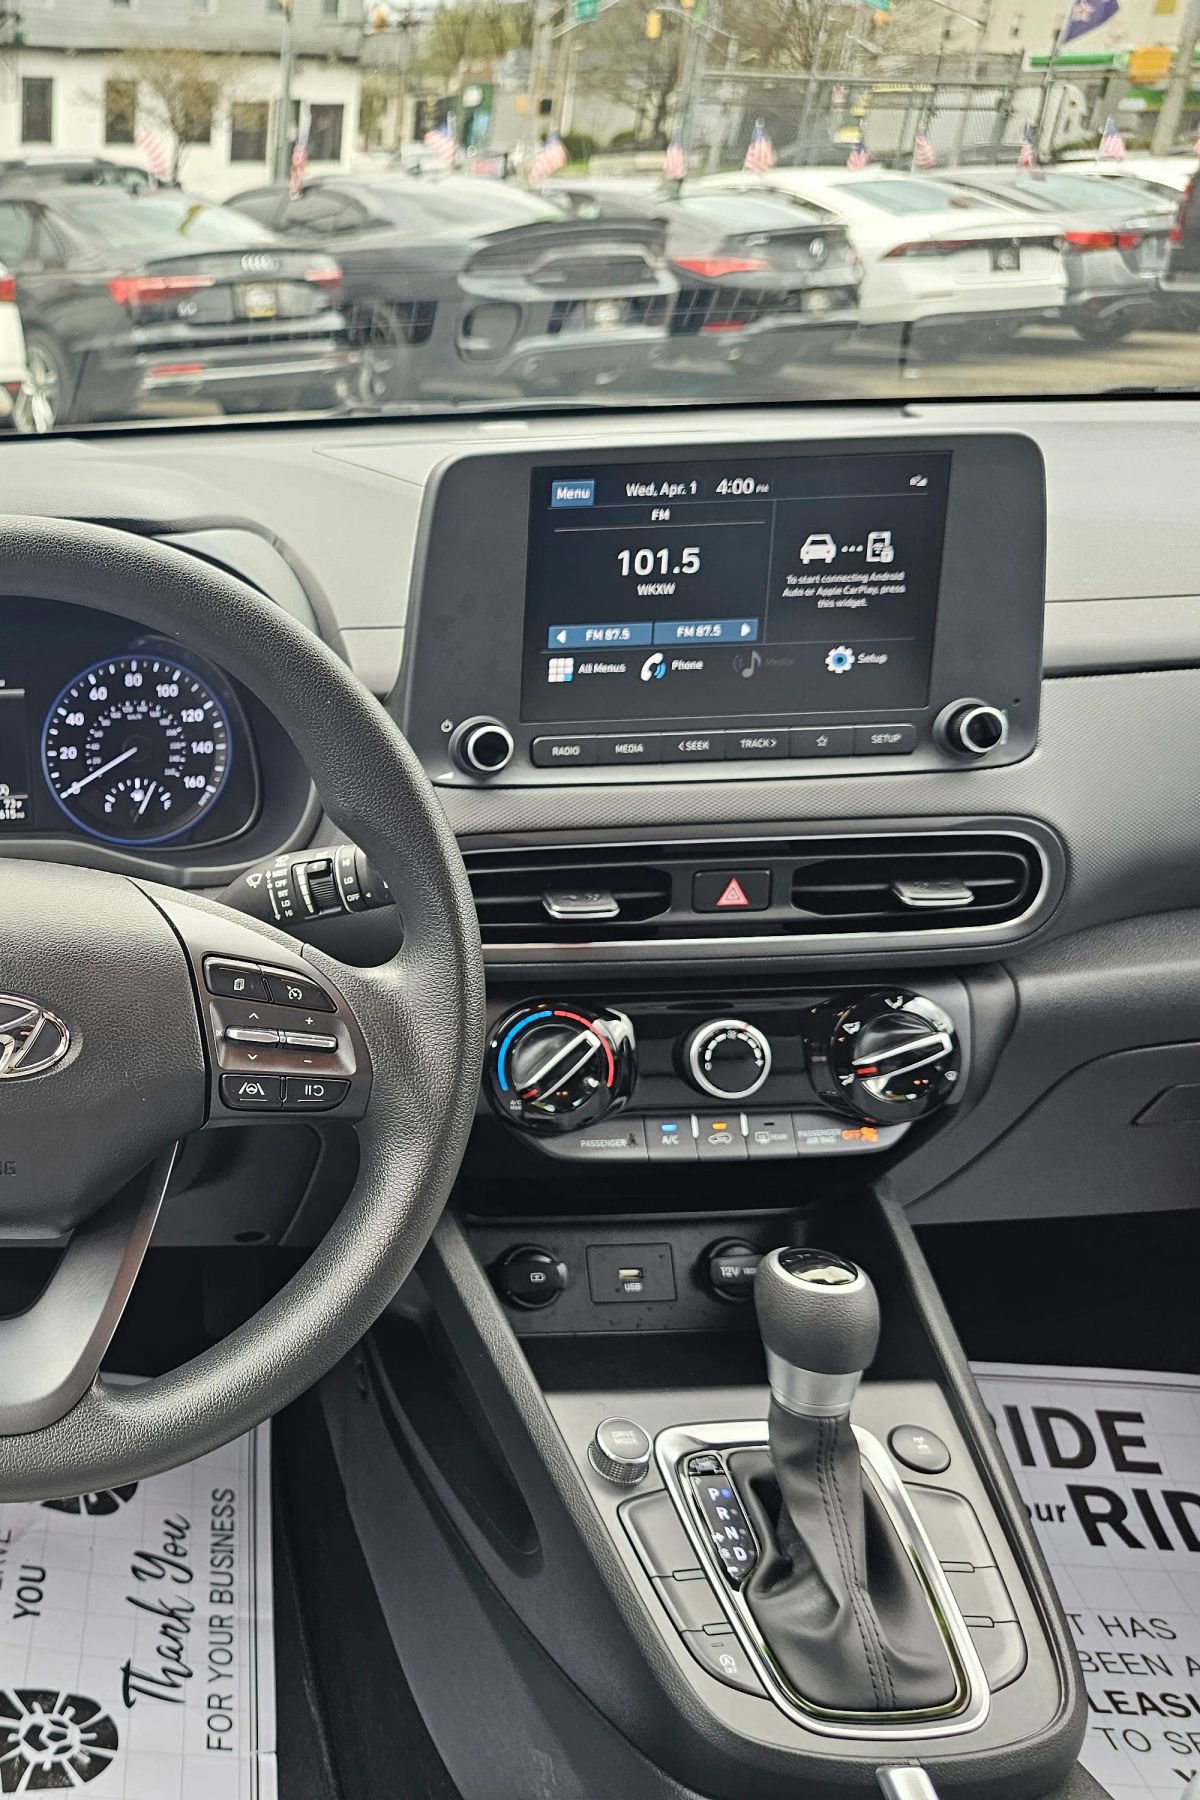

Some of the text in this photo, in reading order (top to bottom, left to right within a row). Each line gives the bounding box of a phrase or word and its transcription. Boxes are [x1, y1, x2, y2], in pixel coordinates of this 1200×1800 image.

[555, 487, 590, 500] Menu
[626, 481, 658, 497] Wed,
[659, 481, 687, 498] Apr.
[689, 480, 697, 495] 1
[715, 477, 755, 496] 4:00
[651, 507, 671, 522] FM
[617, 547, 700, 577] 101.5
[786, 570, 905, 585] To start connecting Android
[636, 582, 677, 597] WKXW
[782, 586, 804, 597] Auto
[804, 587, 816, 597] or
[816, 585, 842, 598] Apple
[880, 584, 906, 595] press
[817, 598, 835, 609] this
[585, 627, 631, 642] FM 87.5
[676, 624, 722, 638] FM 87.5
[671, 659, 704, 671] Phone
[857, 652, 888, 664] Setup
[578, 662, 627, 675] All Menus
[124, 673, 143, 687] 80
[89, 686, 108, 701] 60
[156, 684, 179, 698] 100
[65, 712, 85, 726] 40
[181, 708, 204, 723] 120
[685, 740, 710, 751] SEEK
[739, 737, 770, 749] TRACK
[870, 732, 902, 745] SETUP
[59, 746, 78, 760] 20
[191, 741, 214, 754] 140
[551, 745, 580, 757] RADIO
[615, 743, 644, 755] MEDIA
[183, 775, 206, 789] 160
[163, 800, 172, 811] F
[274, 879, 288, 888] OFF
[346, 892, 361, 902] OFF
[797, 1128, 841, 1137] PASSENGER
[580, 1138, 627, 1148] PASSENGER
[661, 1135, 680, 1145] A/C
[720, 1266, 742, 1278] 12V
[623, 1282, 643, 1293] USB
[613, 1437, 638, 1445] MODE
[1002, 1404, 1163, 1475] IDE
[707, 1487, 720, 1500] P
[715, 1506, 731, 1521] R
[1023, 1503, 1066, 1523] ur
[723, 1526, 740, 1540] N
[733, 1547, 748, 1561] D
[12, 1564, 47, 1620] YOU
[120, 1512, 196, 1709] Thank You
[206, 1487, 236, 1752] FOR YOUR BUSINESS
[1064, 1613, 1177, 1640] T HAS
[1077, 1650, 1174, 1677] BEEN
[1086, 1689, 1200, 1718] LEAS
[1091, 1726, 1152, 1753] TO
